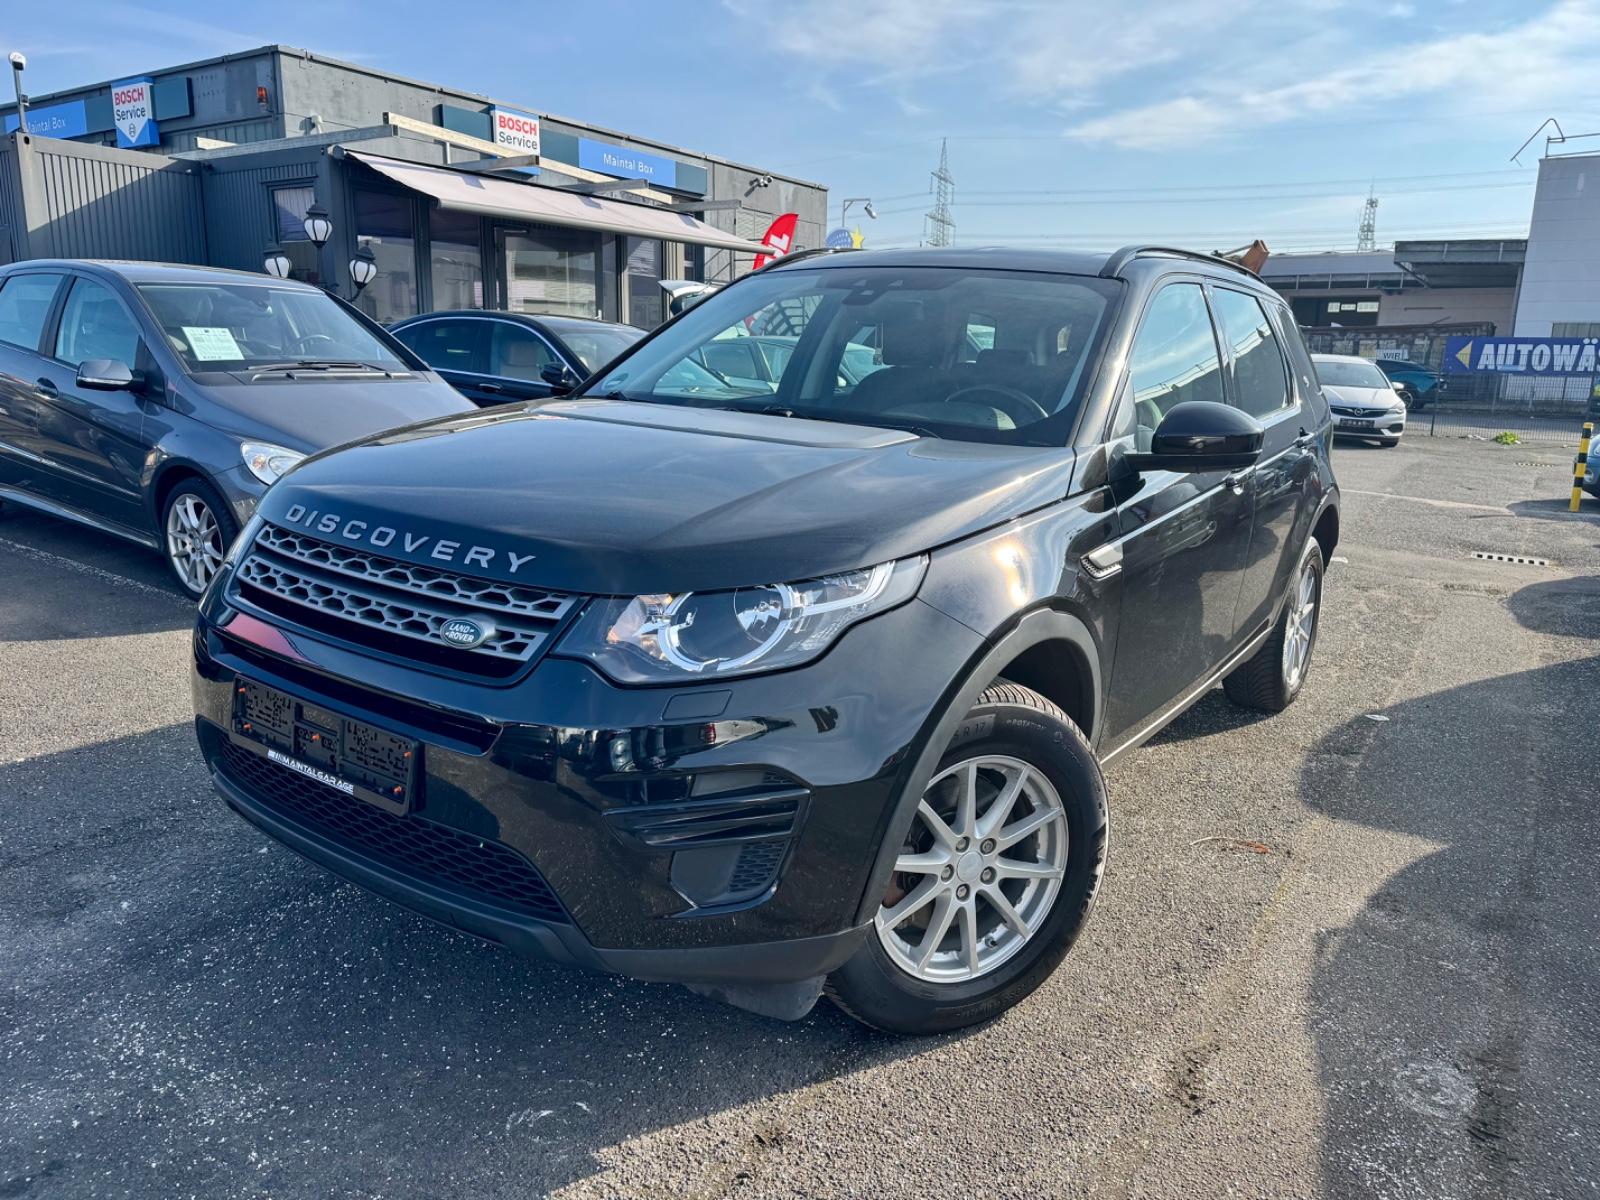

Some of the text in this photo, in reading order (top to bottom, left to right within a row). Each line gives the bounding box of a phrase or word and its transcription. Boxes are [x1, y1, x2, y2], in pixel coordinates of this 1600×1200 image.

[114, 87, 145, 106] BOSCH
[52, 117, 66, 129] Box
[115, 106, 146, 122] Service
[498, 115, 537, 136] BOSCH
[498, 131, 538, 150] Service
[603, 153, 654, 175] Maintal Box
[1477, 338, 1600, 372] AUTOWÄ
[285, 503, 536, 574] DISCOVERY
[449, 623, 470, 633] LAND
[449, 631, 475, 643] ROVER
